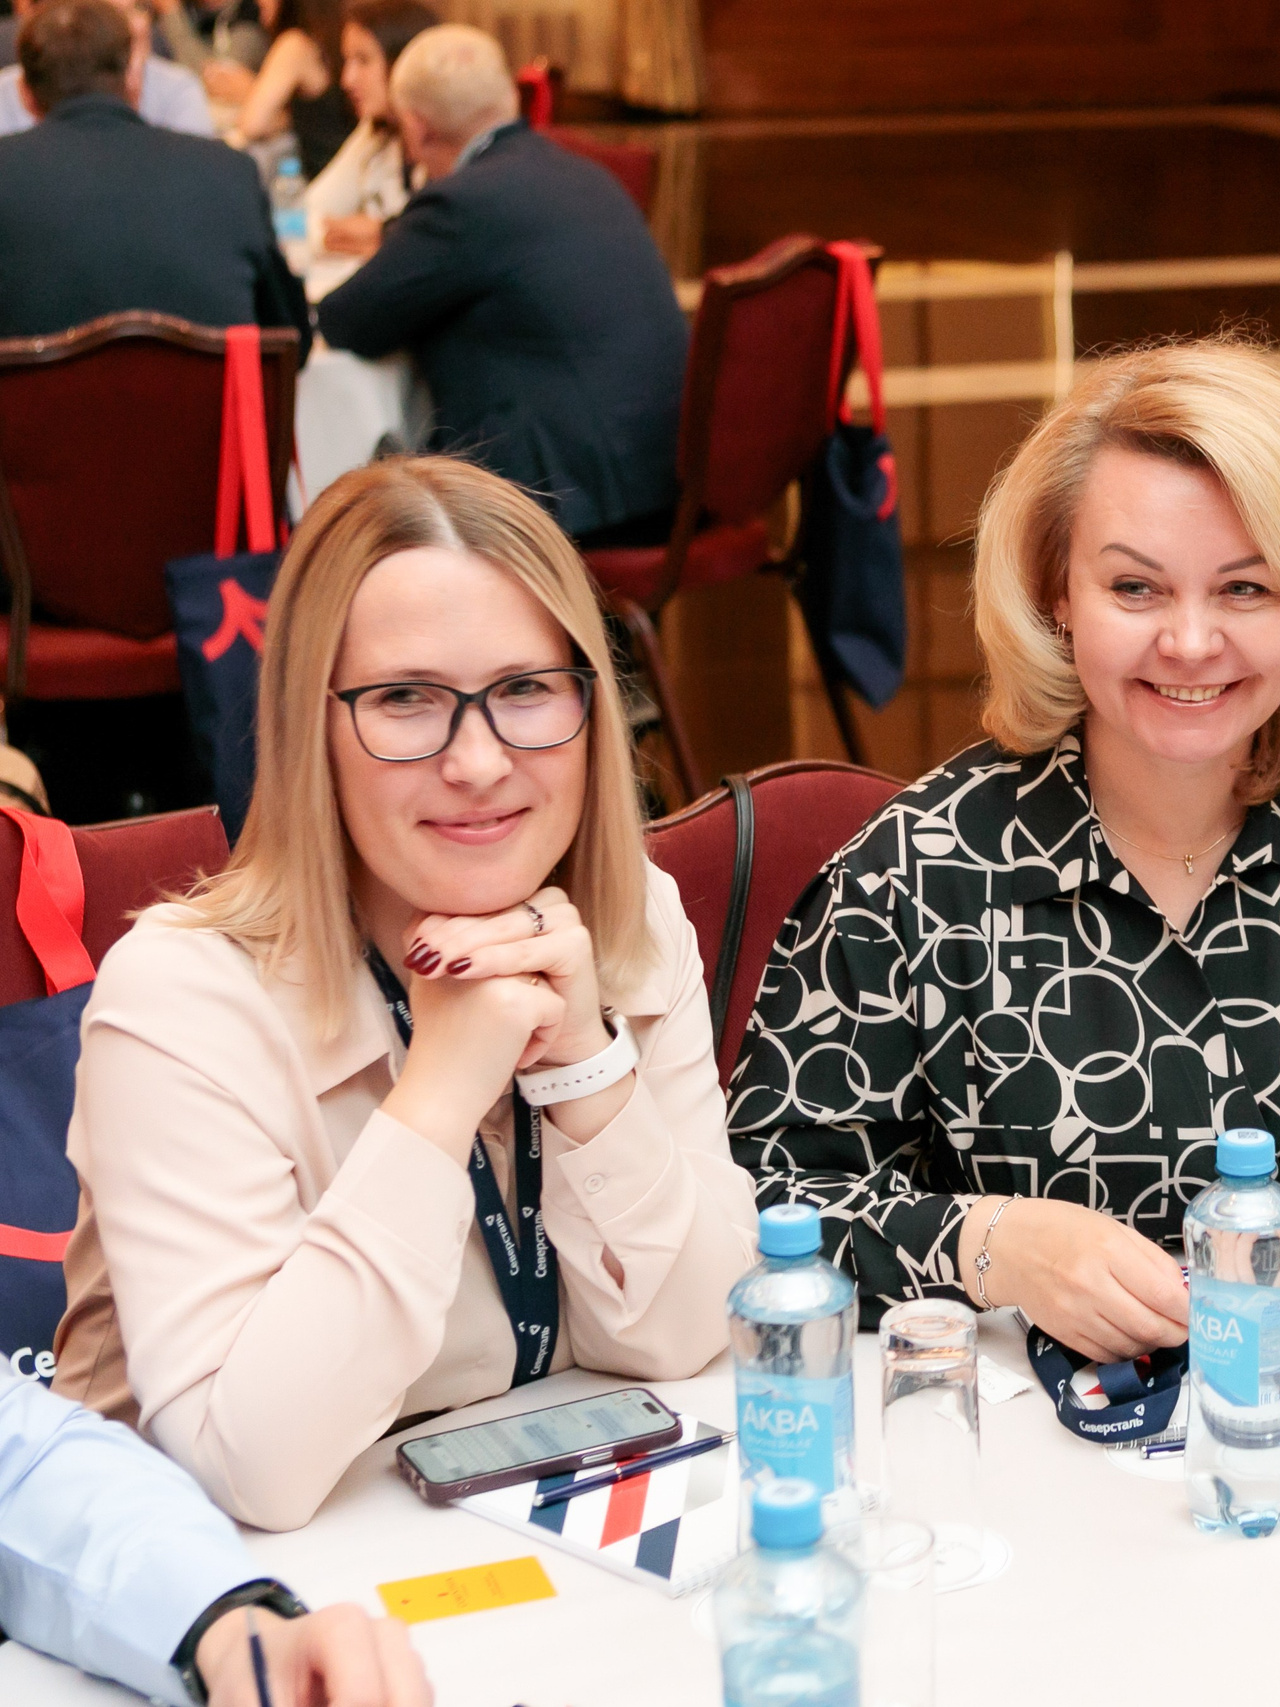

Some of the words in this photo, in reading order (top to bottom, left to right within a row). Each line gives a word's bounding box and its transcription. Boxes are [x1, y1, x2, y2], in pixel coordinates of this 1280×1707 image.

[496, 1213, 521, 1277] Северсталь
[742, 1400, 820, 1437] АКВА
[1078, 1416, 1144, 1436] Северсталь
